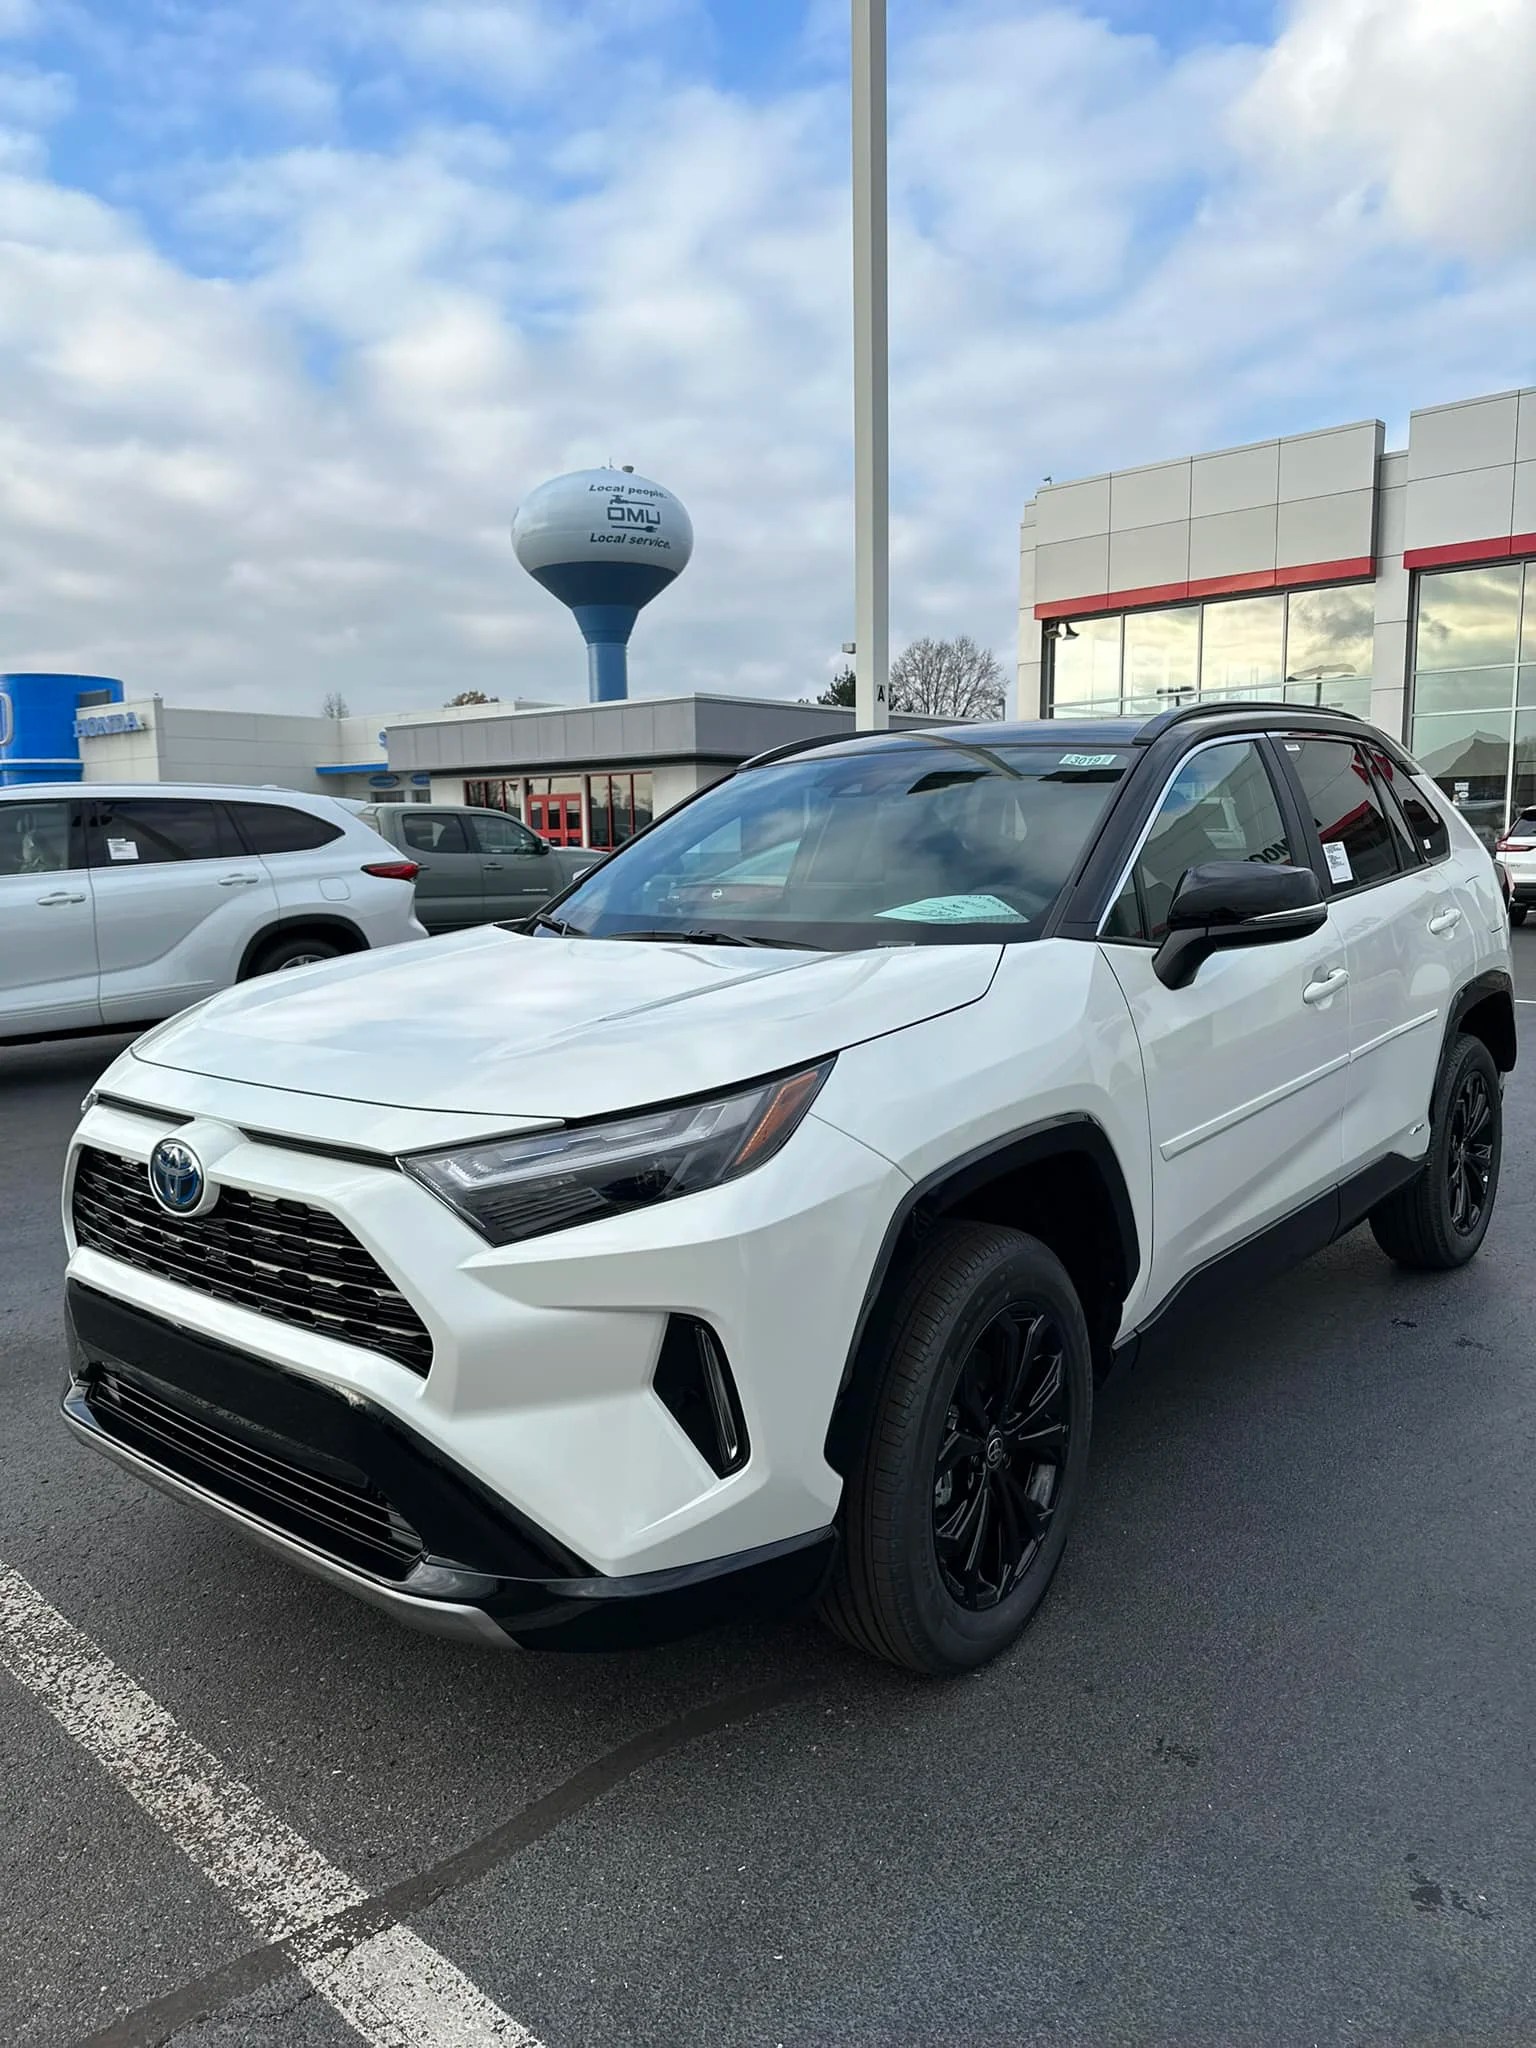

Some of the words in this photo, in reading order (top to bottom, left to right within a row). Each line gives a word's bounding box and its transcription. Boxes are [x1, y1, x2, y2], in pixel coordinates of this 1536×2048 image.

[588, 484, 625, 493] Local
[607, 507, 660, 525] OMU
[590, 532, 627, 543] Local
